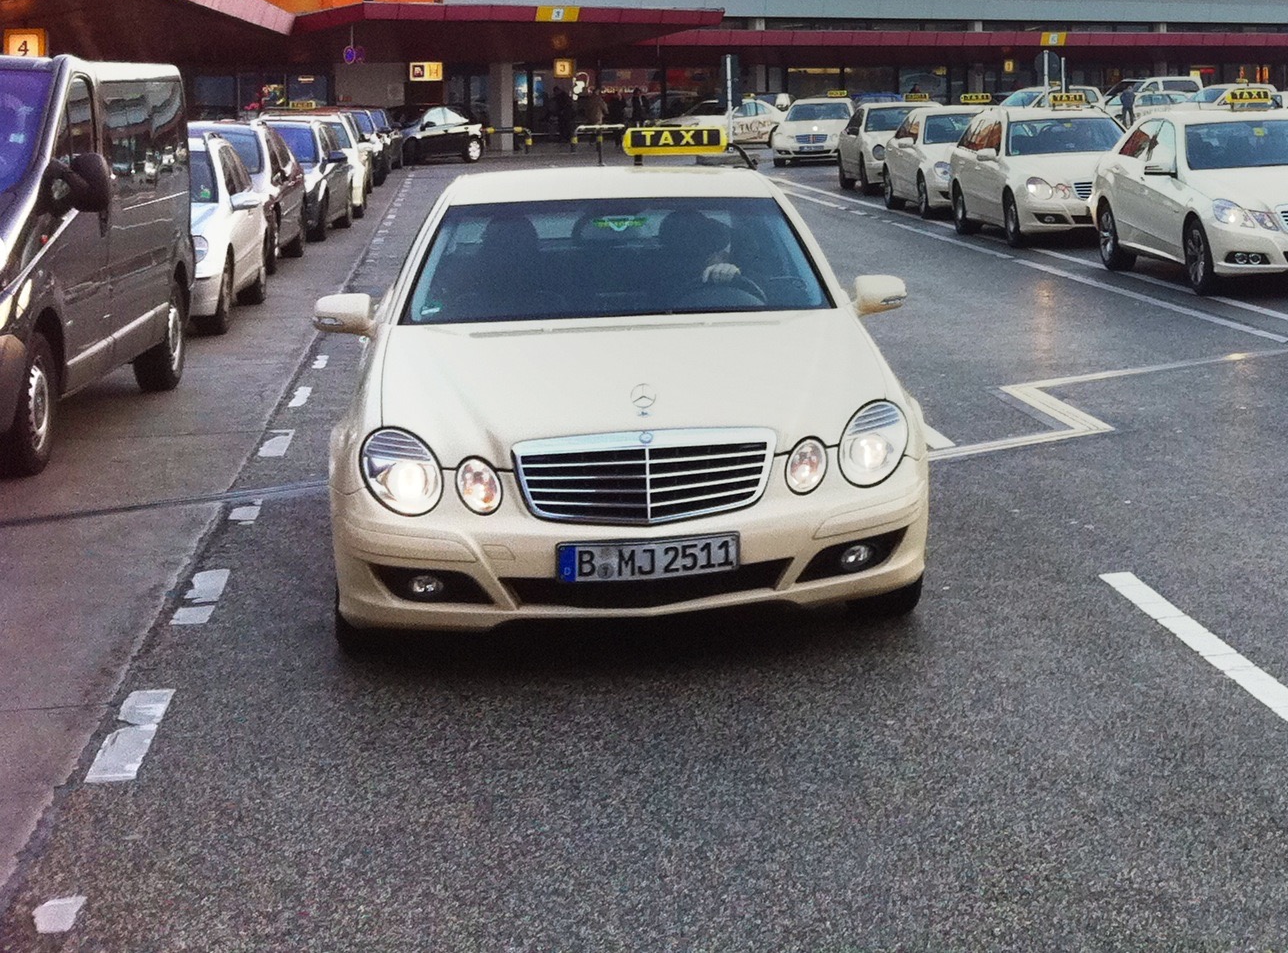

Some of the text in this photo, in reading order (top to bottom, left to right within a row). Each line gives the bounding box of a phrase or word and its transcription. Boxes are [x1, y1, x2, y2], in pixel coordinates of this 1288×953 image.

[17, 40, 29, 56] 4
[1235, 91, 1265, 99] TAXI
[641, 130, 709, 146] TAXI
[578, 539, 734, 577] B MJ 2511
